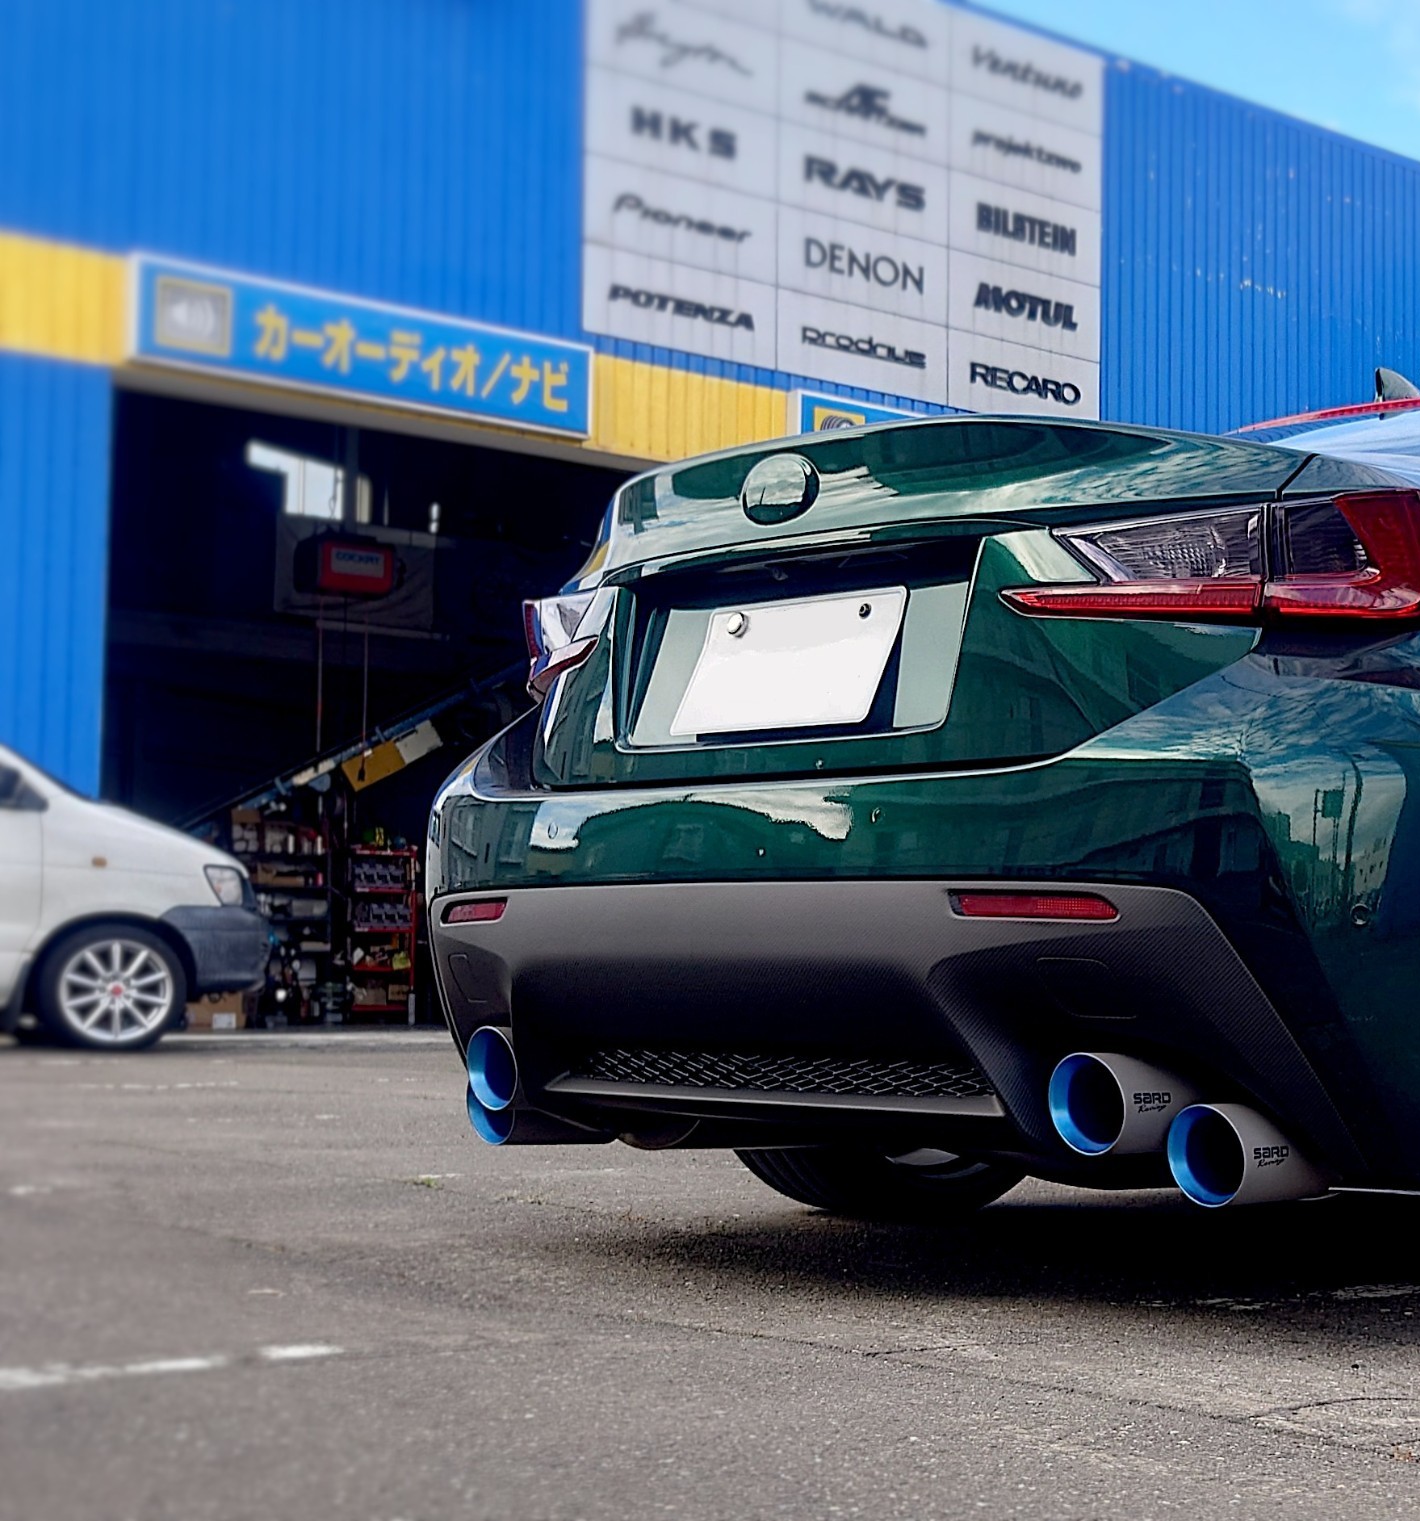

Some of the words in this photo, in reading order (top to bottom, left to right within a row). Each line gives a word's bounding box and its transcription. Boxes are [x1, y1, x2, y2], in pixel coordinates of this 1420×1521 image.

[631, 104, 738, 160] HKS
[804, 153, 926, 212] RAYS
[613, 193, 753, 243] Pioneer
[976, 201, 1077, 257] BILSTEIN
[804, 237, 924, 296] DENON
[608, 282, 755, 332] POTENZA
[974, 281, 1078, 332] MOTUL
[969, 361, 1082, 406] RECARO
